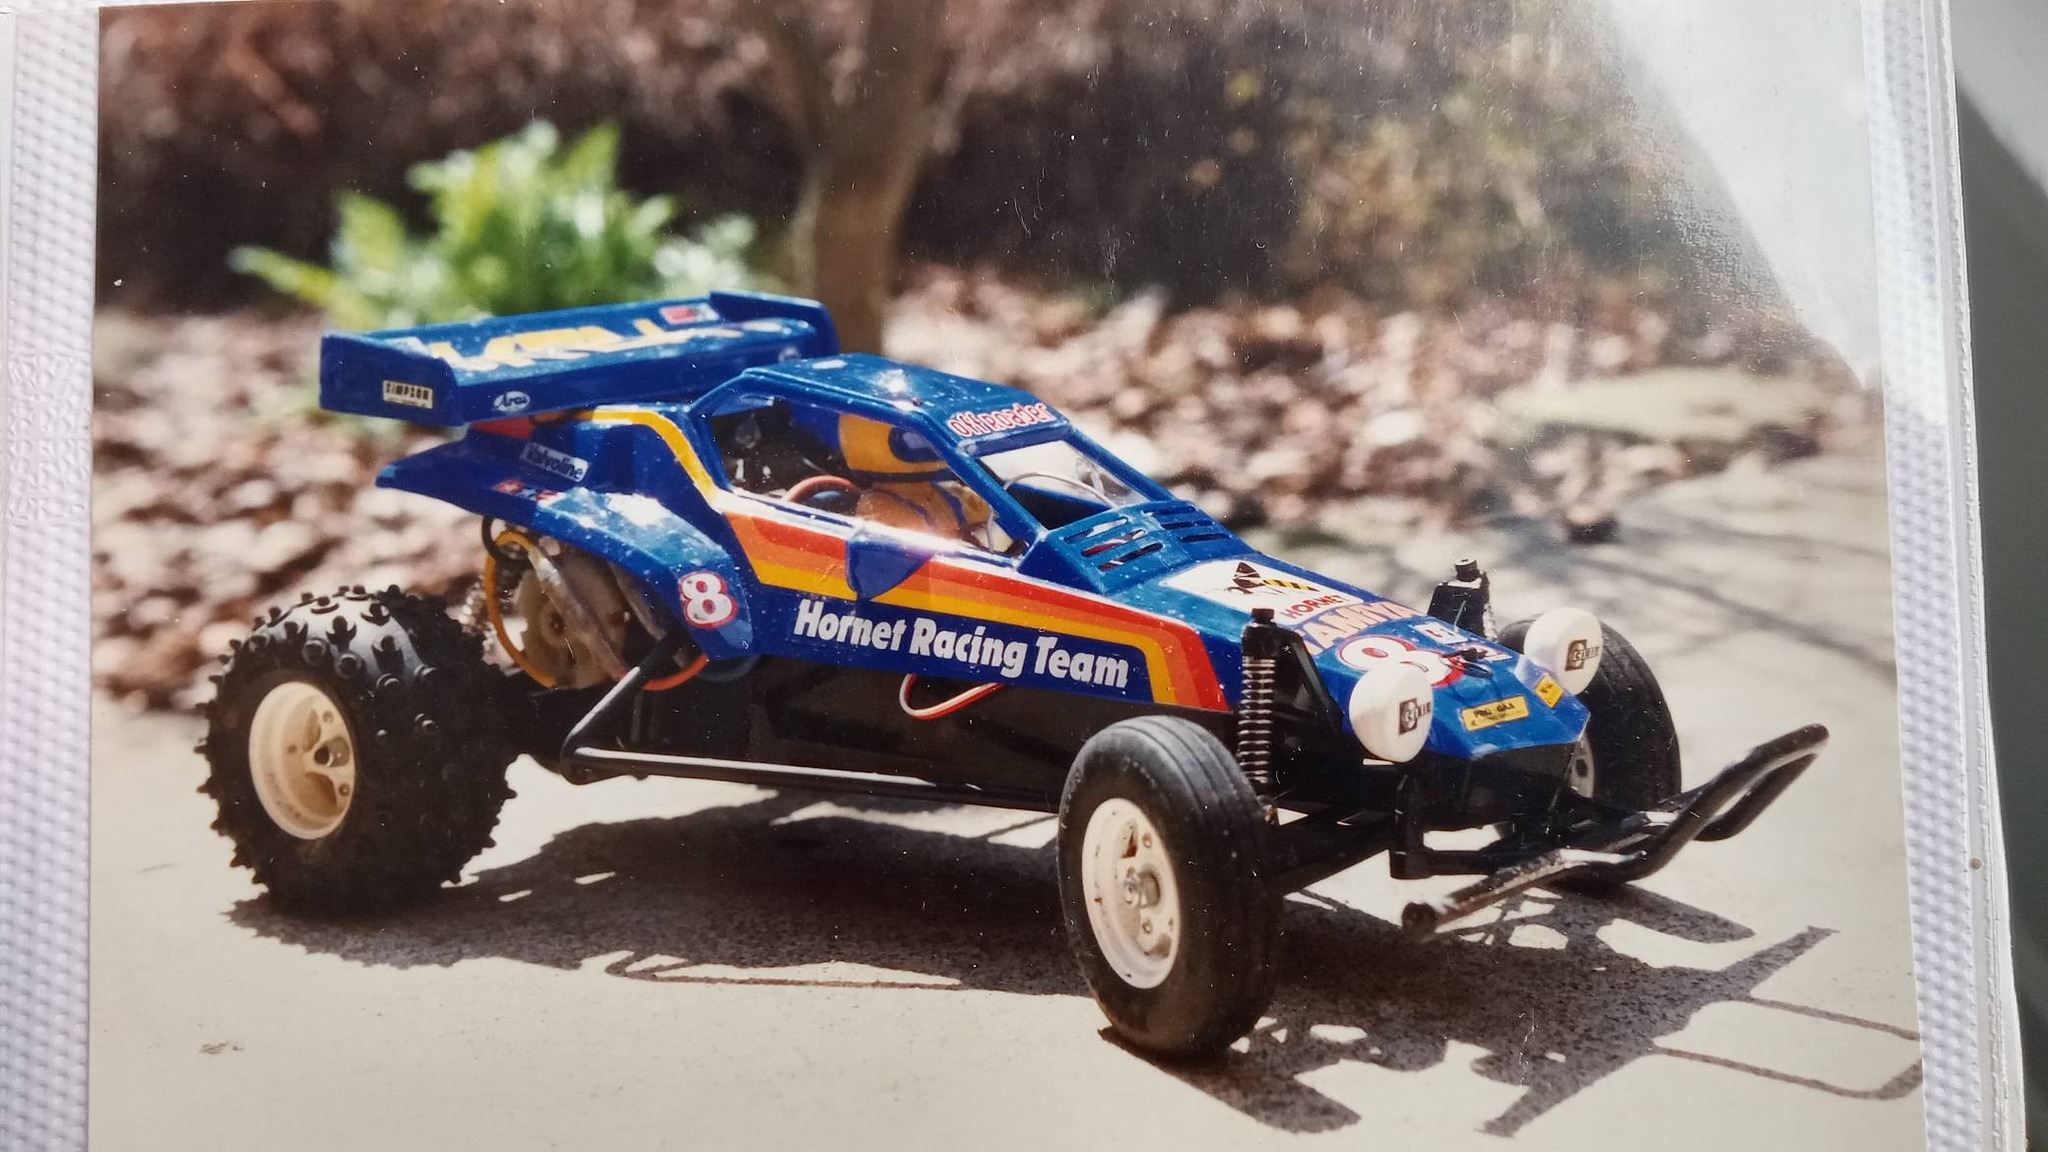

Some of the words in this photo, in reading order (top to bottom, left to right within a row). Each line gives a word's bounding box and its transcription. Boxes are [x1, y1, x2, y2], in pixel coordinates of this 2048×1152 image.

[526, 444, 583, 479] Valvoline
[678, 569, 738, 629] 8
[1281, 594, 1350, 619] HORNET
[793, 598, 906, 652] Hornet
[909, 617, 1028, 679] Racing
[1034, 635, 1130, 689] Team
[1336, 634, 1464, 690] 8
